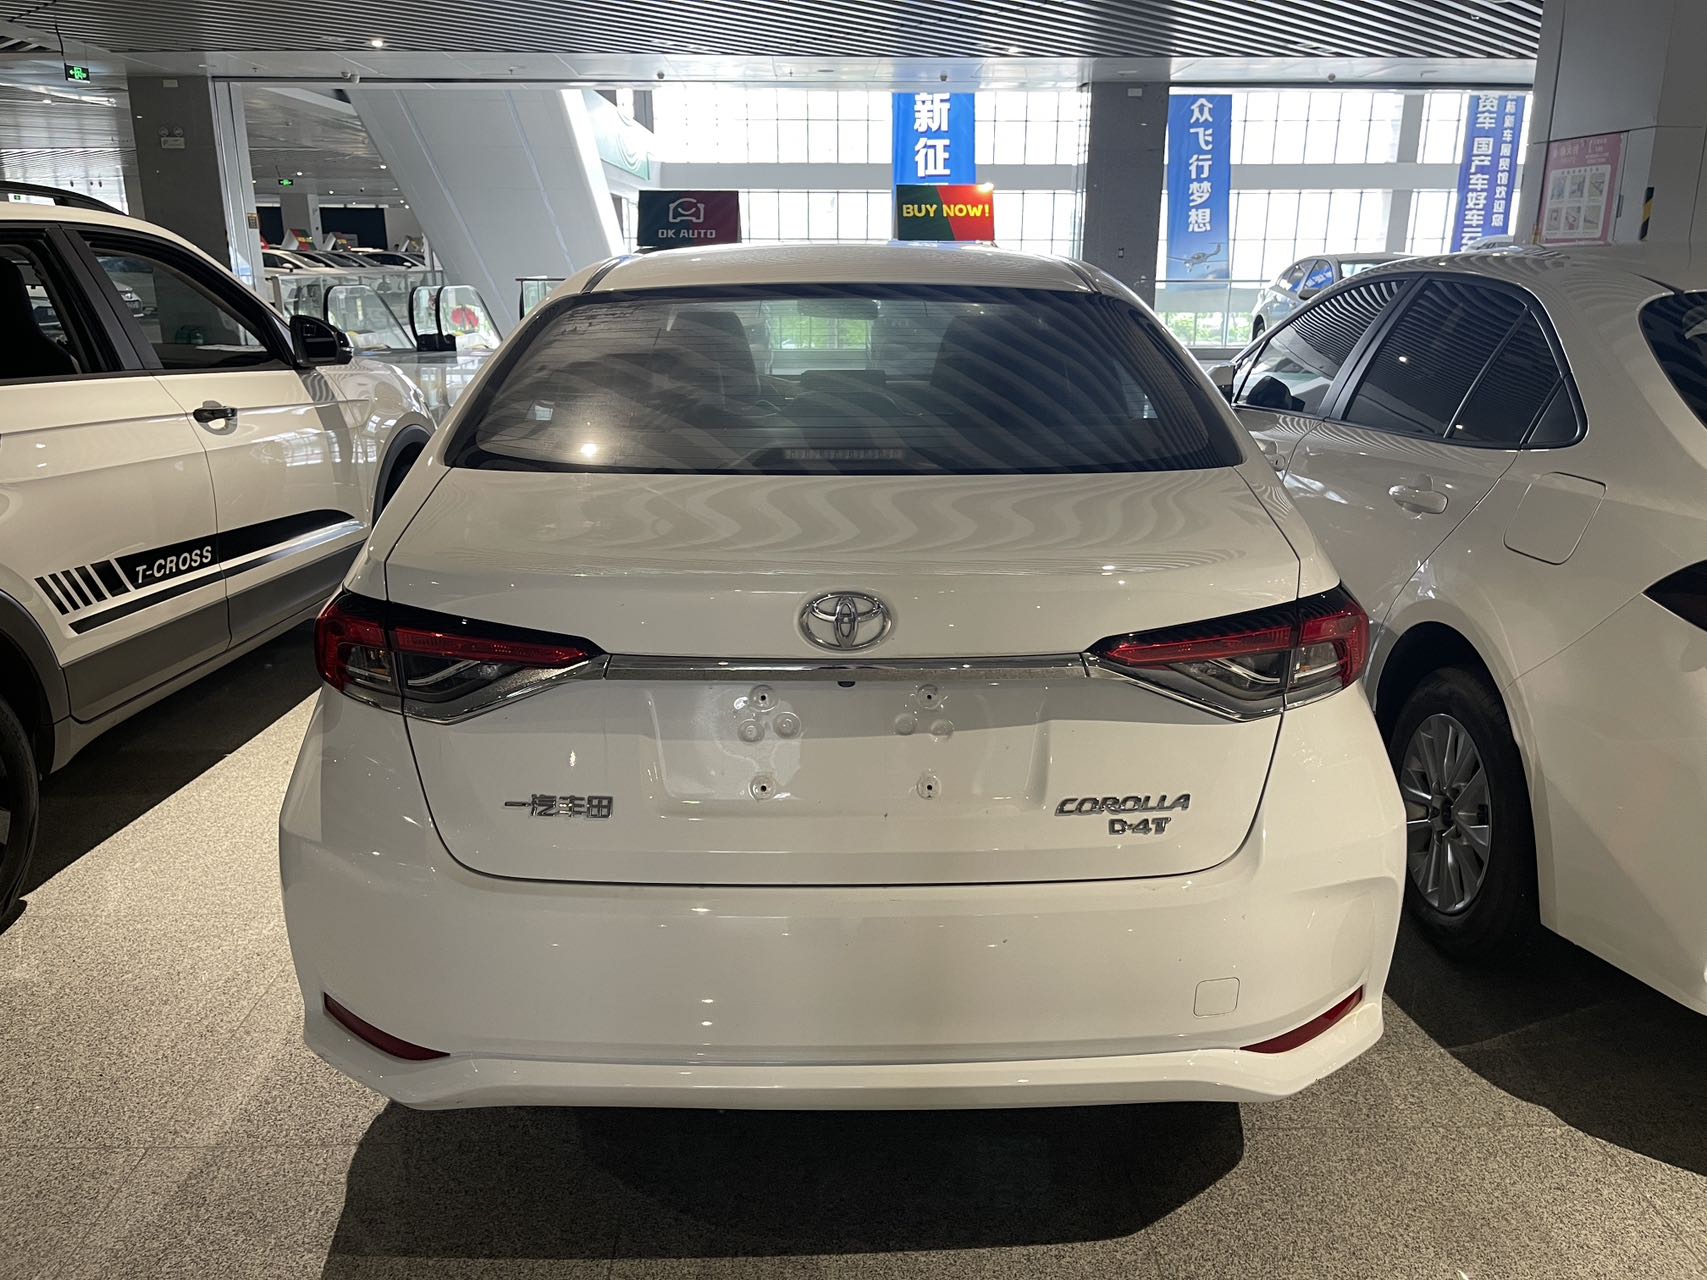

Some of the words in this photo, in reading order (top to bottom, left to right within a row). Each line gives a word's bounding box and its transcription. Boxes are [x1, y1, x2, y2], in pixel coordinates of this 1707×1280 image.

[914, 92, 950, 185] 新征
[1188, 97, 1213, 232] 众飞行梦想
[1460, 137, 1494, 252] 国产车好车云
[902, 204, 937, 217] BUY
[942, 204, 990, 217] NOW!
[658, 229, 676, 238] OK
[680, 229, 716, 238] AUTO
[135, 546, 212, 584] T-CROSS
[504, 794, 613, 818] 一汽丰田
[1054, 793, 1191, 816] COROLLA
